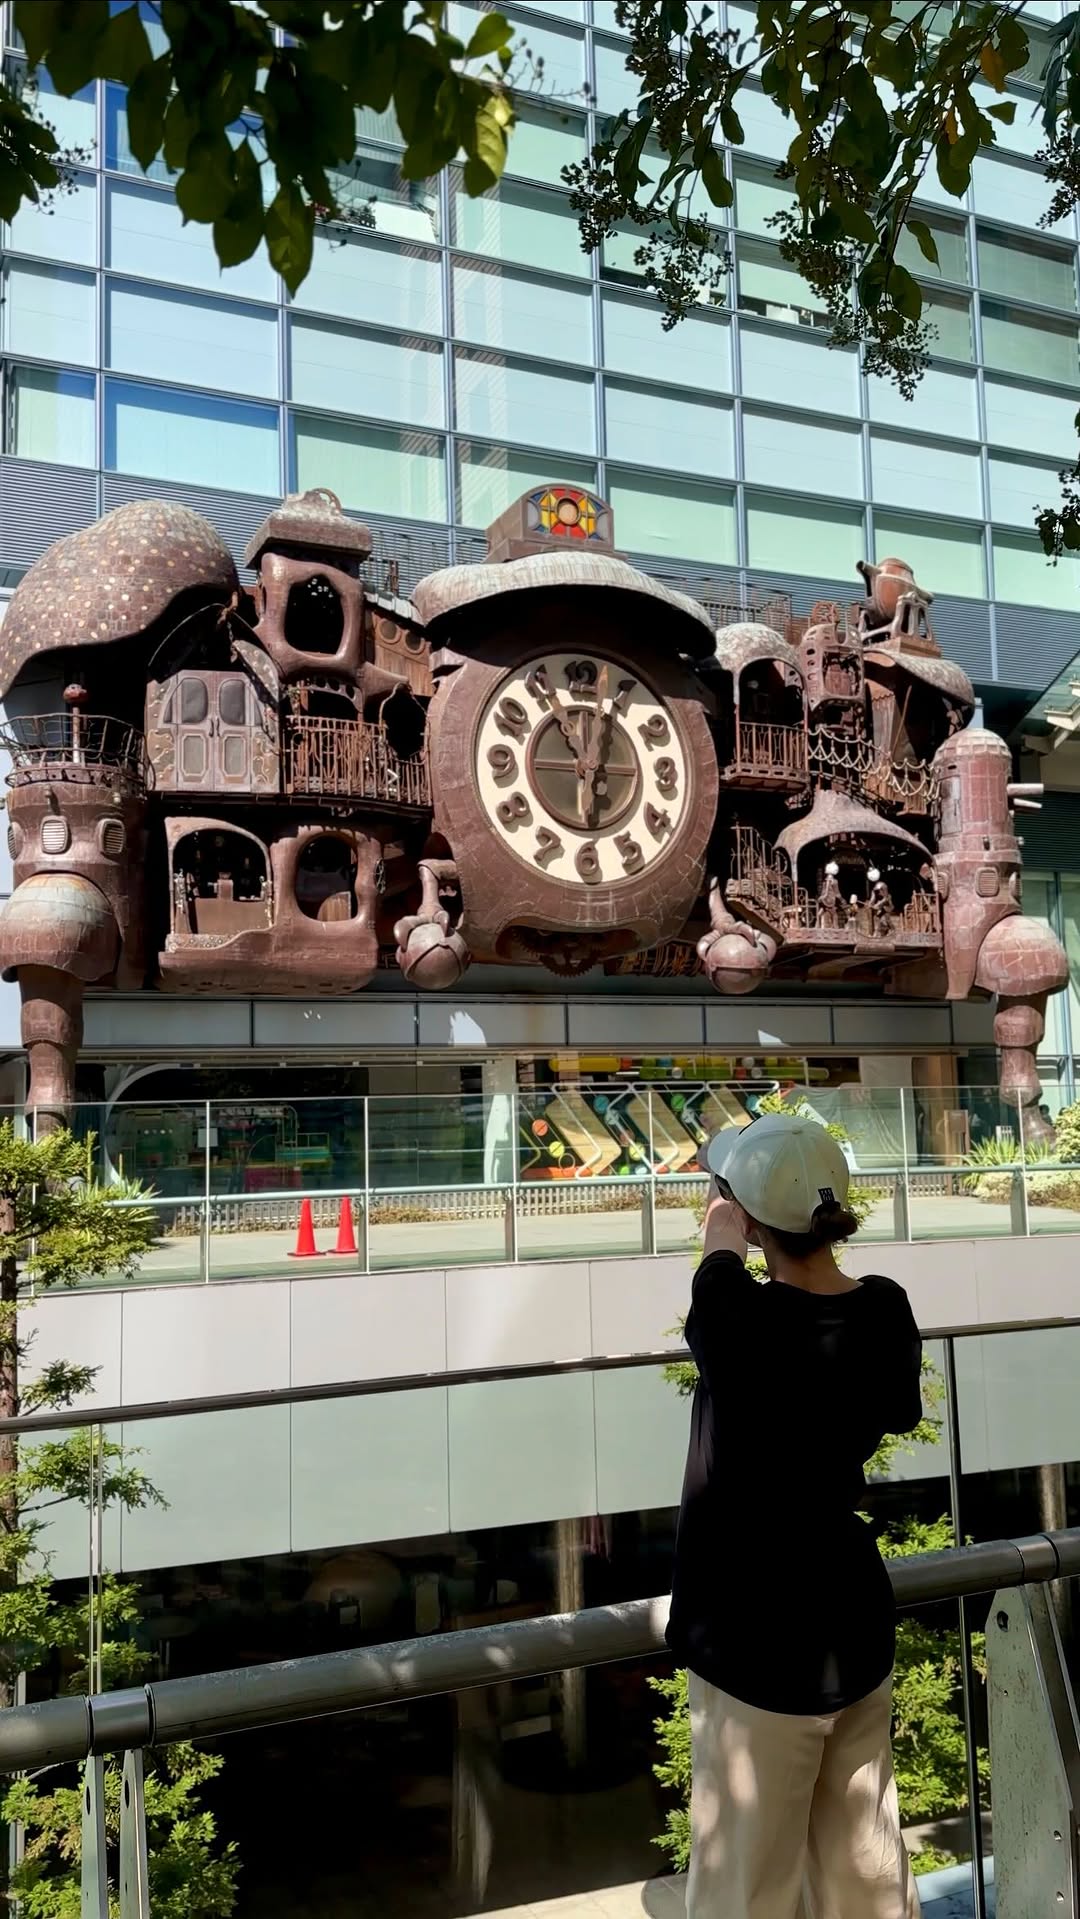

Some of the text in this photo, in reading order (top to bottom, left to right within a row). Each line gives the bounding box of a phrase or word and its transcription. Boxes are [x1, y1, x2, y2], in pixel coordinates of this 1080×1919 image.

[524, 664, 556, 699] 11
[564, 660, 598, 694] 12
[615, 679, 637, 709] 1
[494, 697, 528, 736] 10
[638, 714, 668, 746] 2
[487, 744, 515, 779] 9
[654, 756, 677, 791] 3
[496, 792, 529, 823] 8
[644, 802, 671, 834] 4
[534, 827, 561, 861] 7
[575, 839, 599, 875] 6
[614, 830, 642, 866] 5
